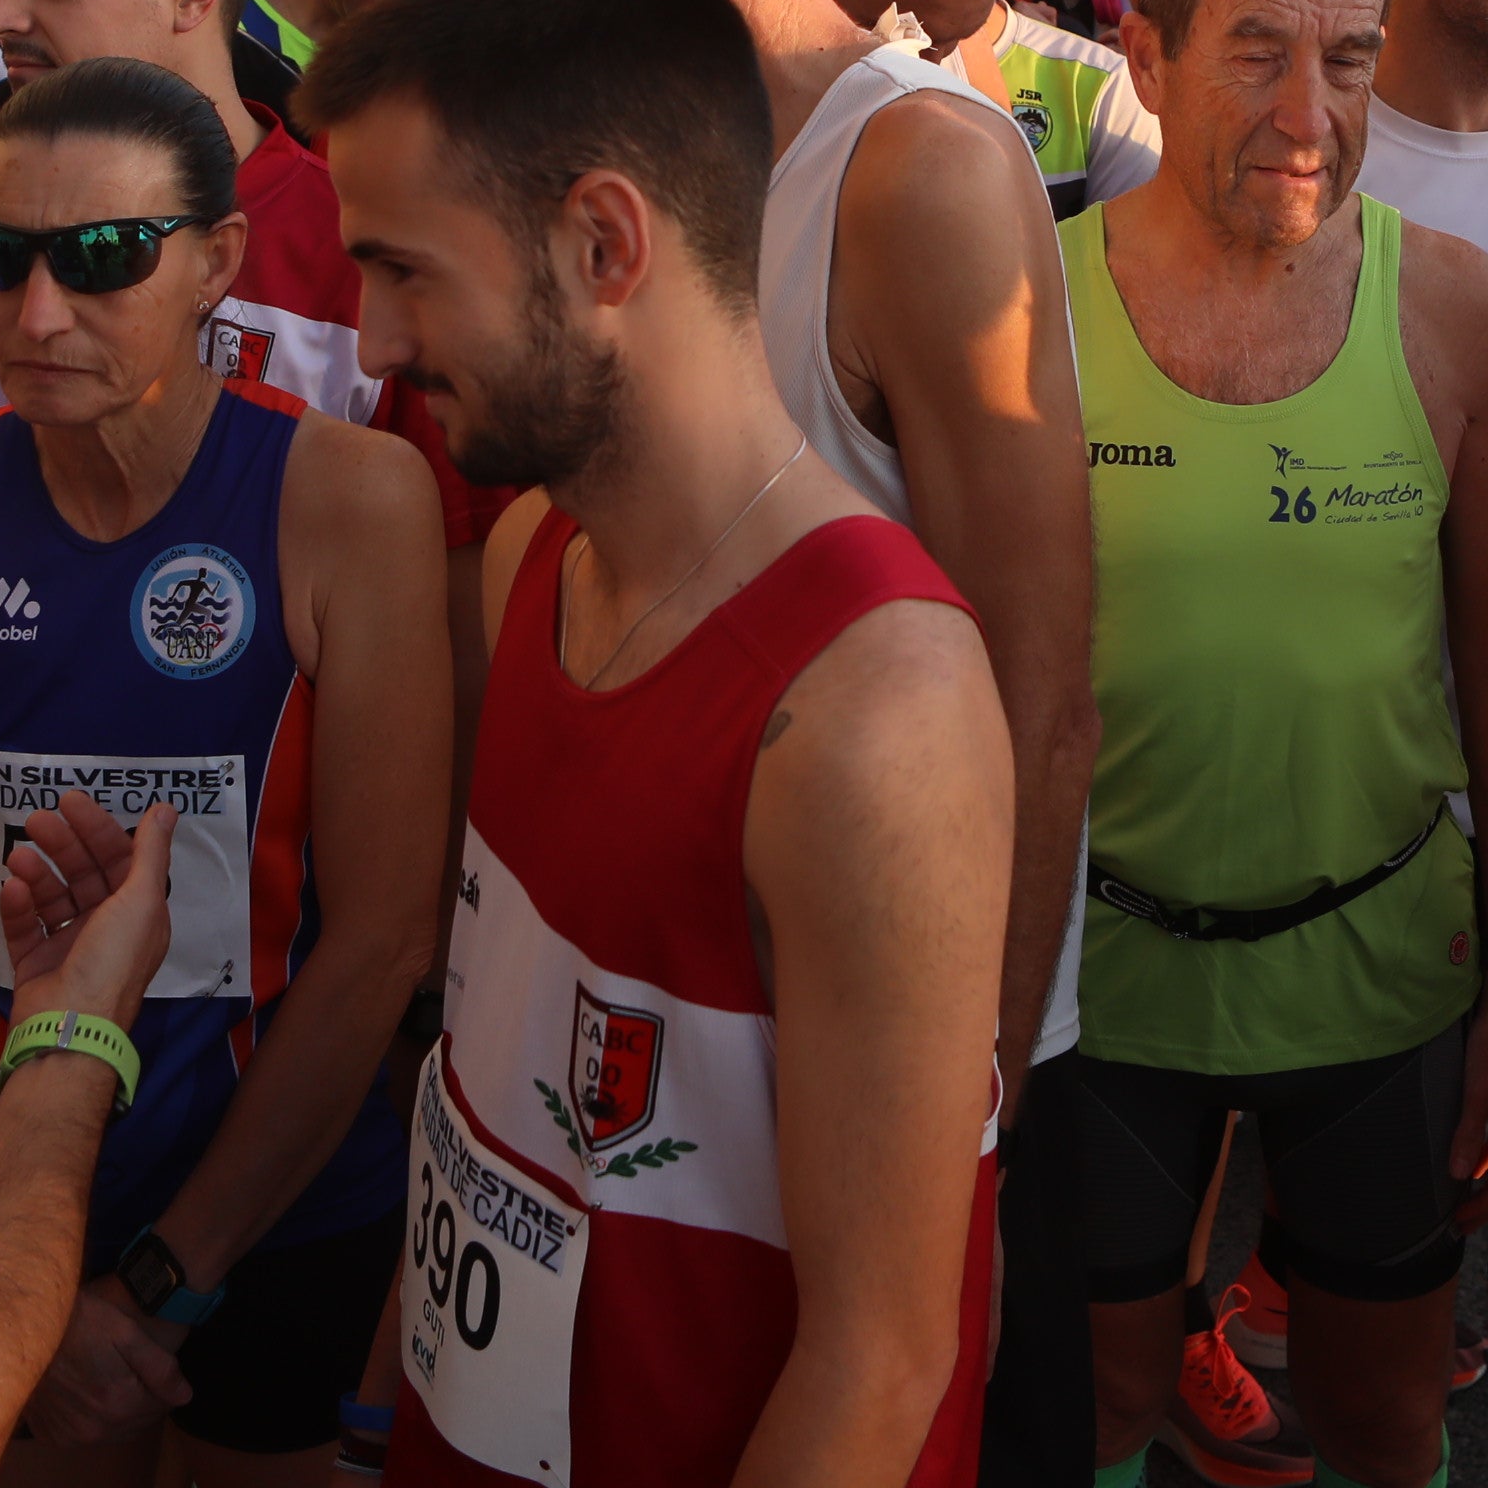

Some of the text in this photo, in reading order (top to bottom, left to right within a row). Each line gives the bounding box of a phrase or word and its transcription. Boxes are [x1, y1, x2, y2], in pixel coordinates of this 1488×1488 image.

[1016, 88, 1043, 102] JSR
[218, 331, 261, 355] CABC
[1088, 442, 1177, 467] Joma
[1268, 482, 1423, 524] 26 Maratón
[1324, 514, 1363, 525] Ciudad
[1366, 513, 1378, 523] de
[1382, 511, 1411, 522] Sevilla
[150, 546, 246, 585] UNIÓN ATLÉTICA
[153, 637, 246, 678] SAN FERNANDO
[20, 766, 221, 789] SILVESTRE
[78, 788, 112, 812] E
[122, 786, 222, 815] CÁDIZ
[580, 1013, 645, 1055] CABC
[421, 1081, 563, 1274] CIUDAD DE CÁDIZ
[439, 1100, 566, 1240] SILVESTRE
[413, 1161, 501, 1352] 390
[423, 1298, 445, 1347] GUTI
